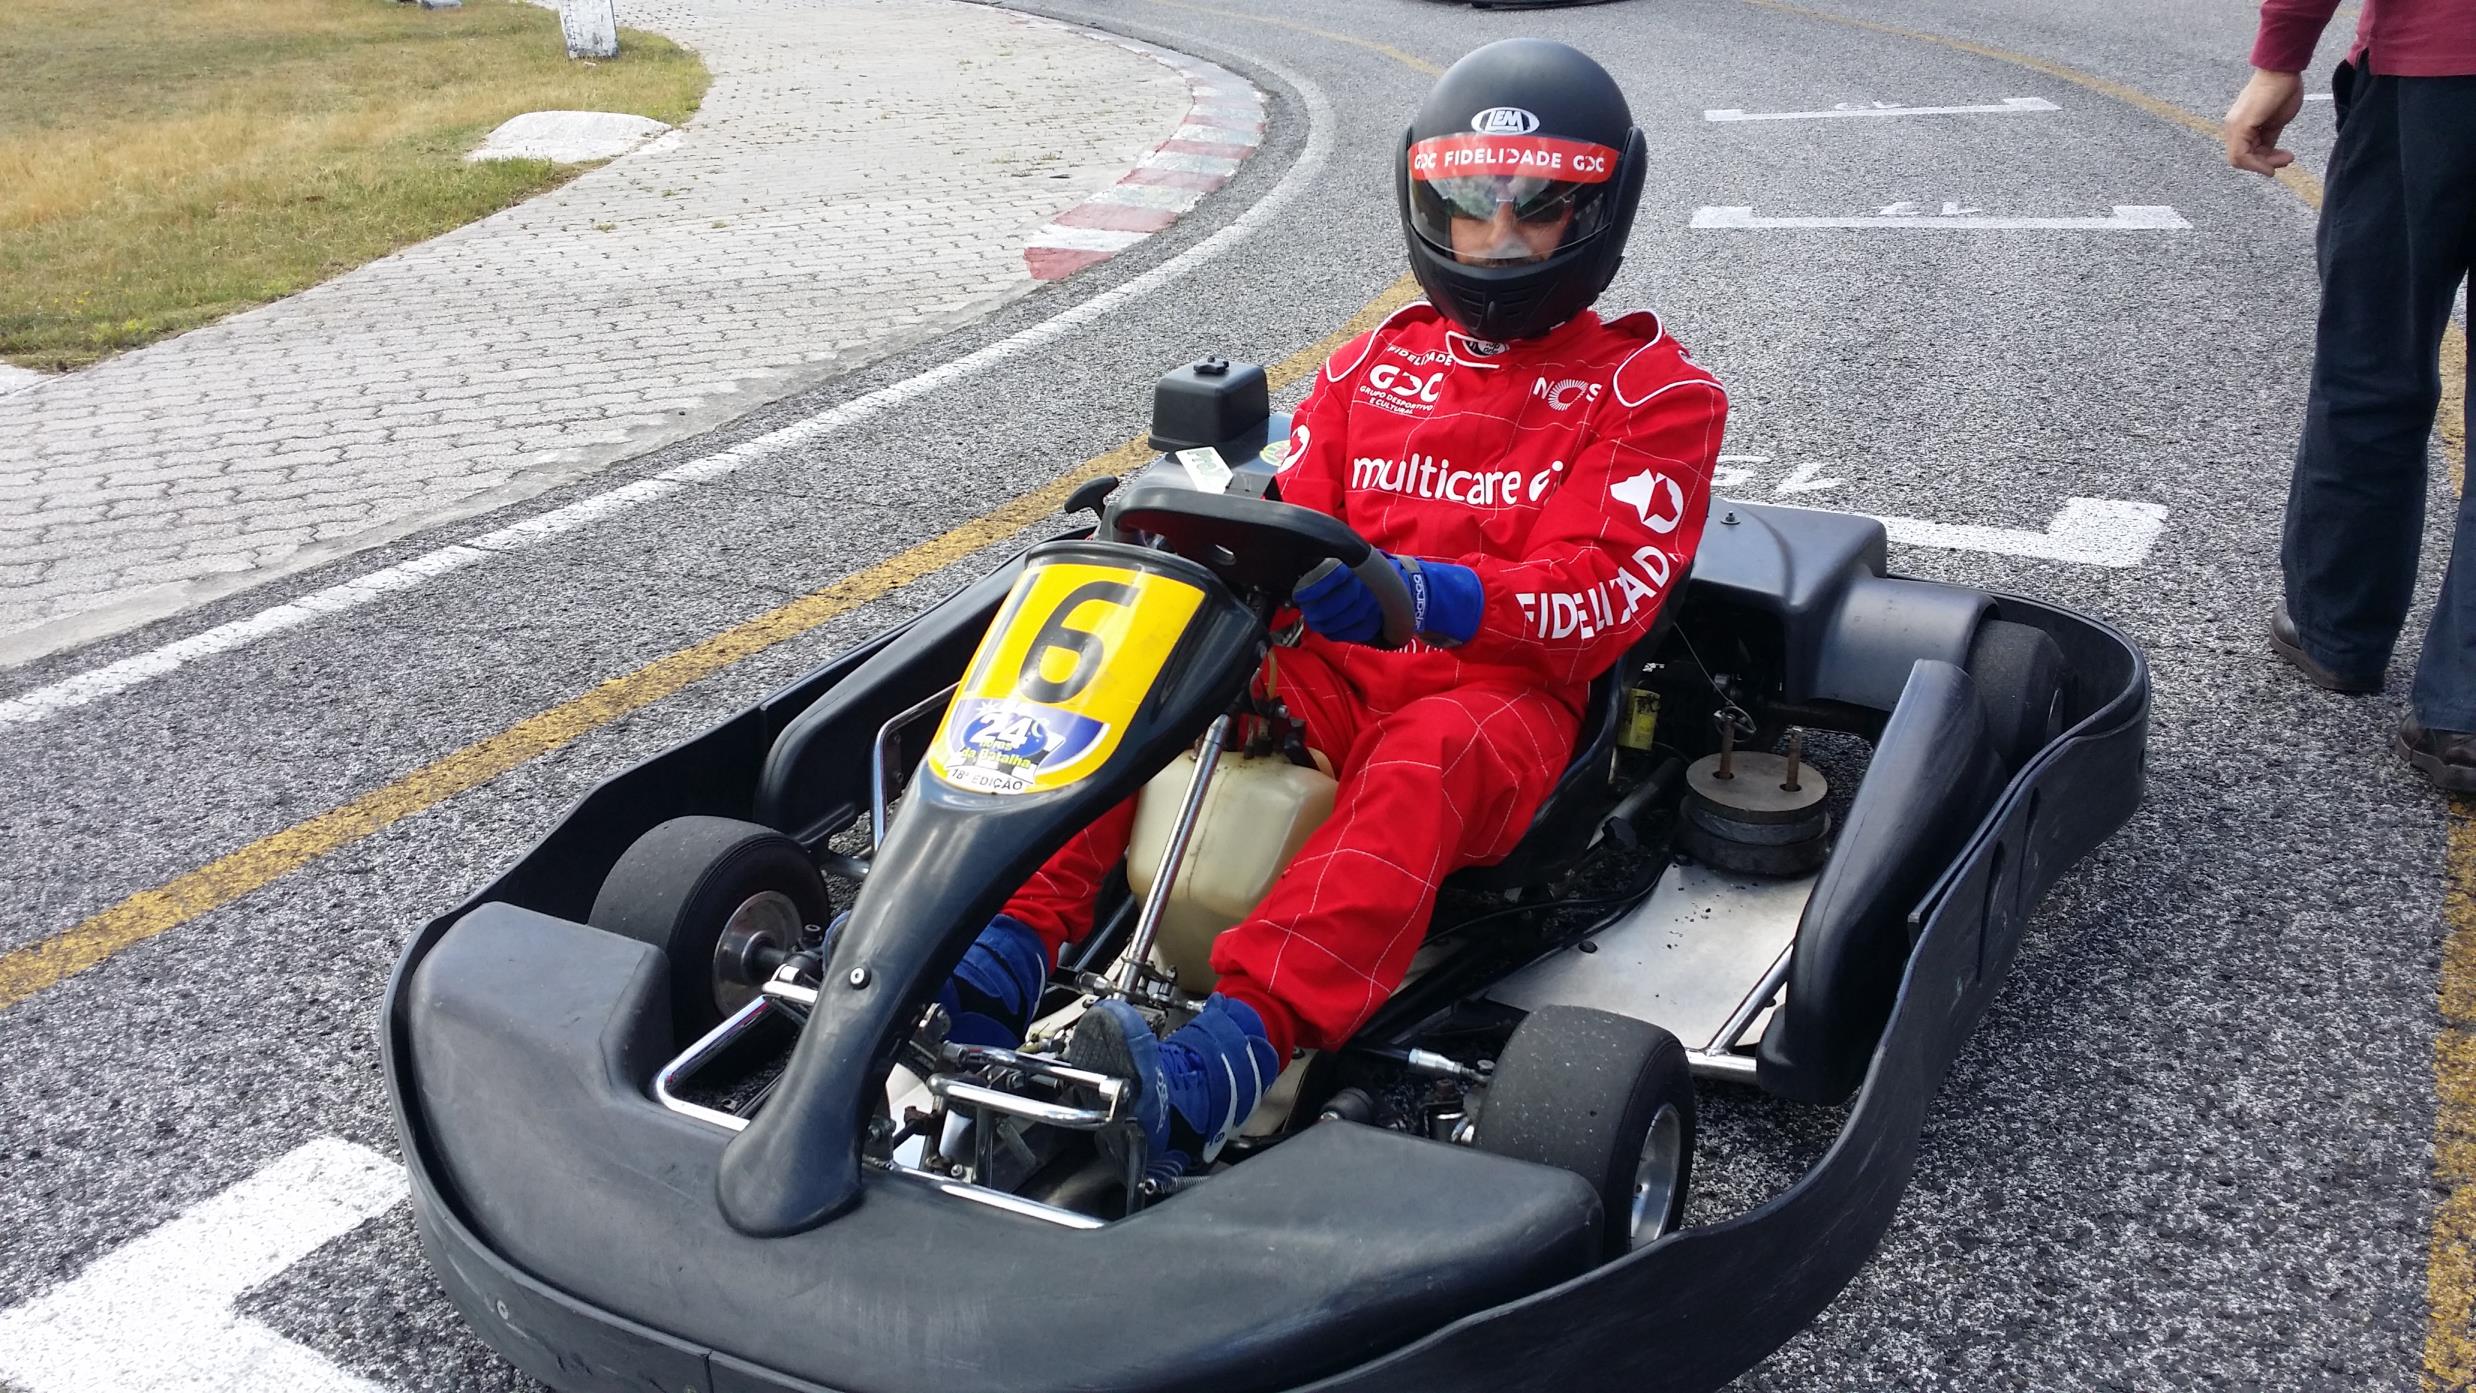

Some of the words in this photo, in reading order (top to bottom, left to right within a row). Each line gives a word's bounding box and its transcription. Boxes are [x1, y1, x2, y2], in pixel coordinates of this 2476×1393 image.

[1444, 147, 1563, 169] FIDELIDADE
[1359, 385, 1387, 399] GRUPO
[1387, 393, 1434, 411] DESPORTIVO
[1369, 396, 1376, 404] E
[1375, 398, 1414, 415] CULTURAL
[1351, 453, 1522, 505] multicare
[1017, 580, 1142, 705] 6
[968, 711, 1034, 749] 24
[972, 774, 1024, 791] EDIÇÃO
